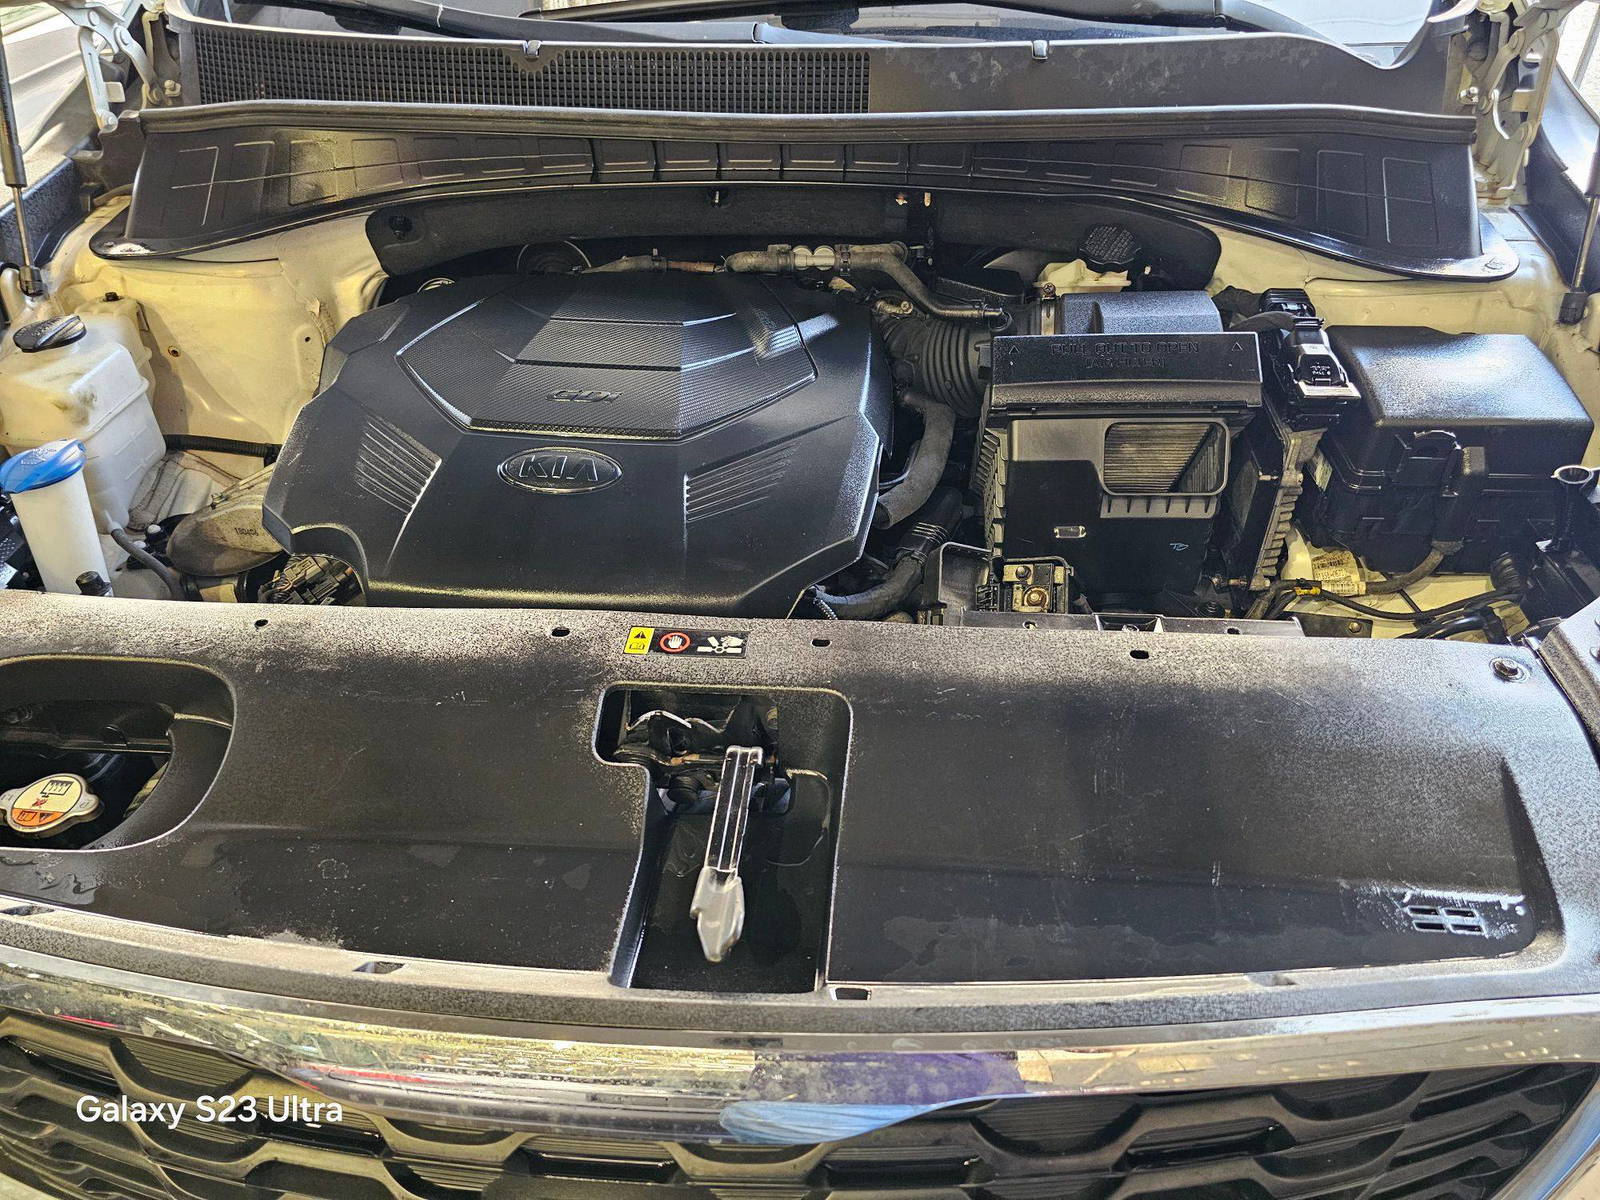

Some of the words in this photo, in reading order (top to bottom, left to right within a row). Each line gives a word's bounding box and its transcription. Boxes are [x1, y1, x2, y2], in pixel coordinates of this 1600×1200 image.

[1050, 342, 1086, 356] PULL
[1095, 341, 1127, 354] OUT
[1130, 341, 1151, 354] TO
[1156, 340, 1199, 353] OPEN
[519, 454, 599, 481] KIA
